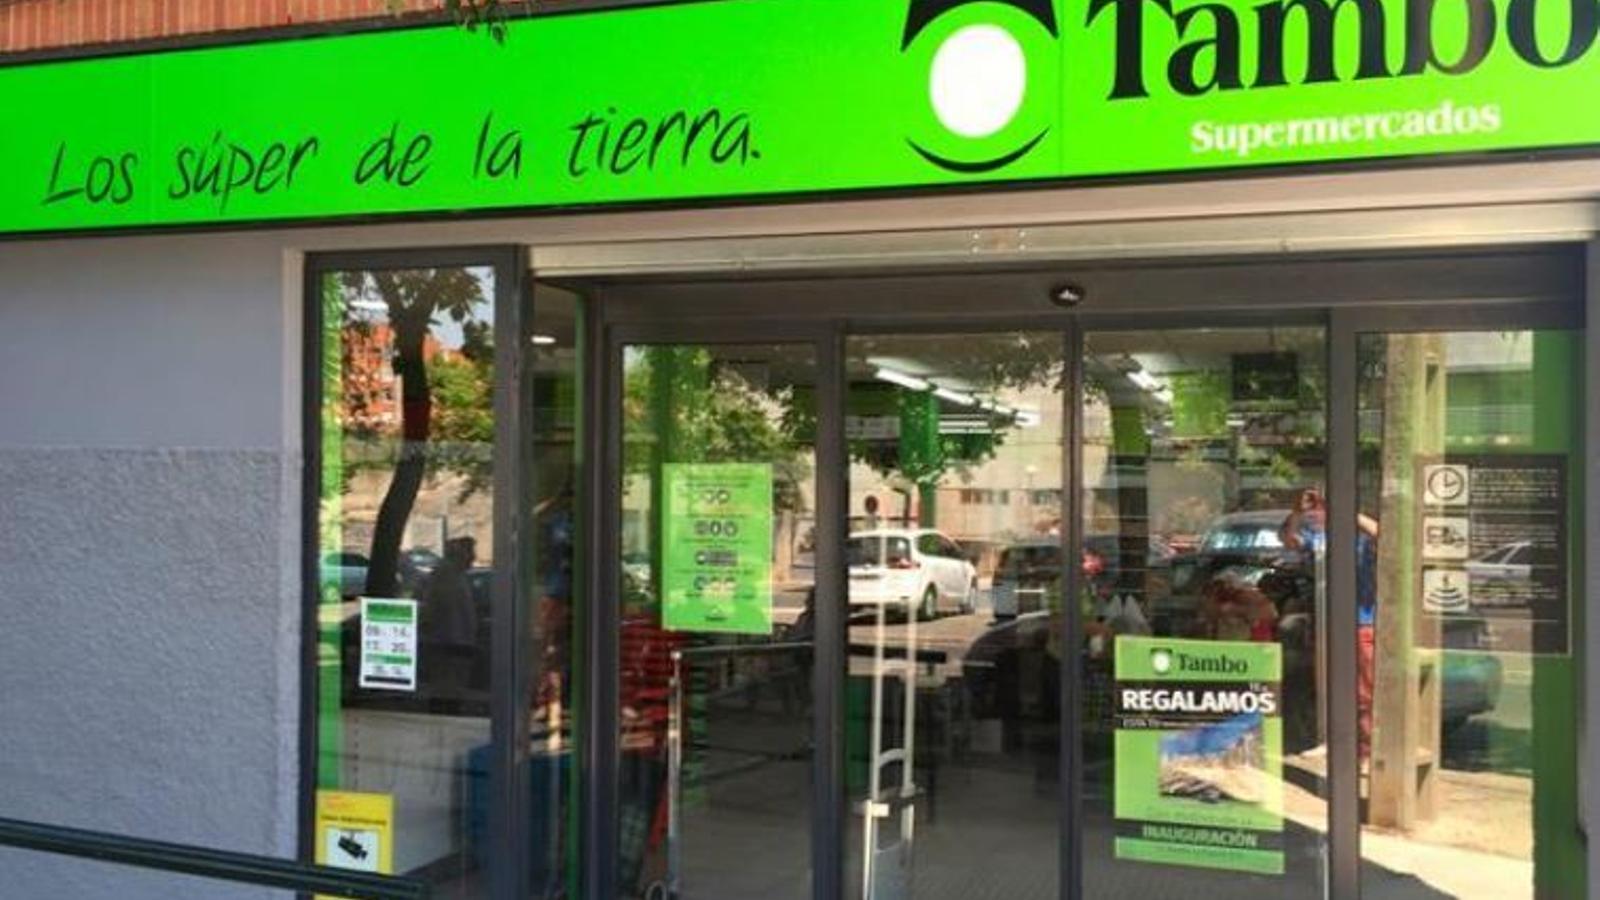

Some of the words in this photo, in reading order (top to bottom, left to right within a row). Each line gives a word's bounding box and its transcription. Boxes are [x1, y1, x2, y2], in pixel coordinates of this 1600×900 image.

[1084, 0, 1600, 101] Tambo
[1190, 99, 1502, 156] Supermercados
[41, 140, 138, 206] Los
[168, 129, 319, 213] súper
[354, 120, 433, 187] de
[472, 109, 522, 179] la
[567, 105, 762, 178] tierra.
[1176, 653, 1248, 674] Tambo
[1121, 688, 1277, 714] REGALAMOS
[1141, 824, 1260, 848] INAUGURACIÓN
